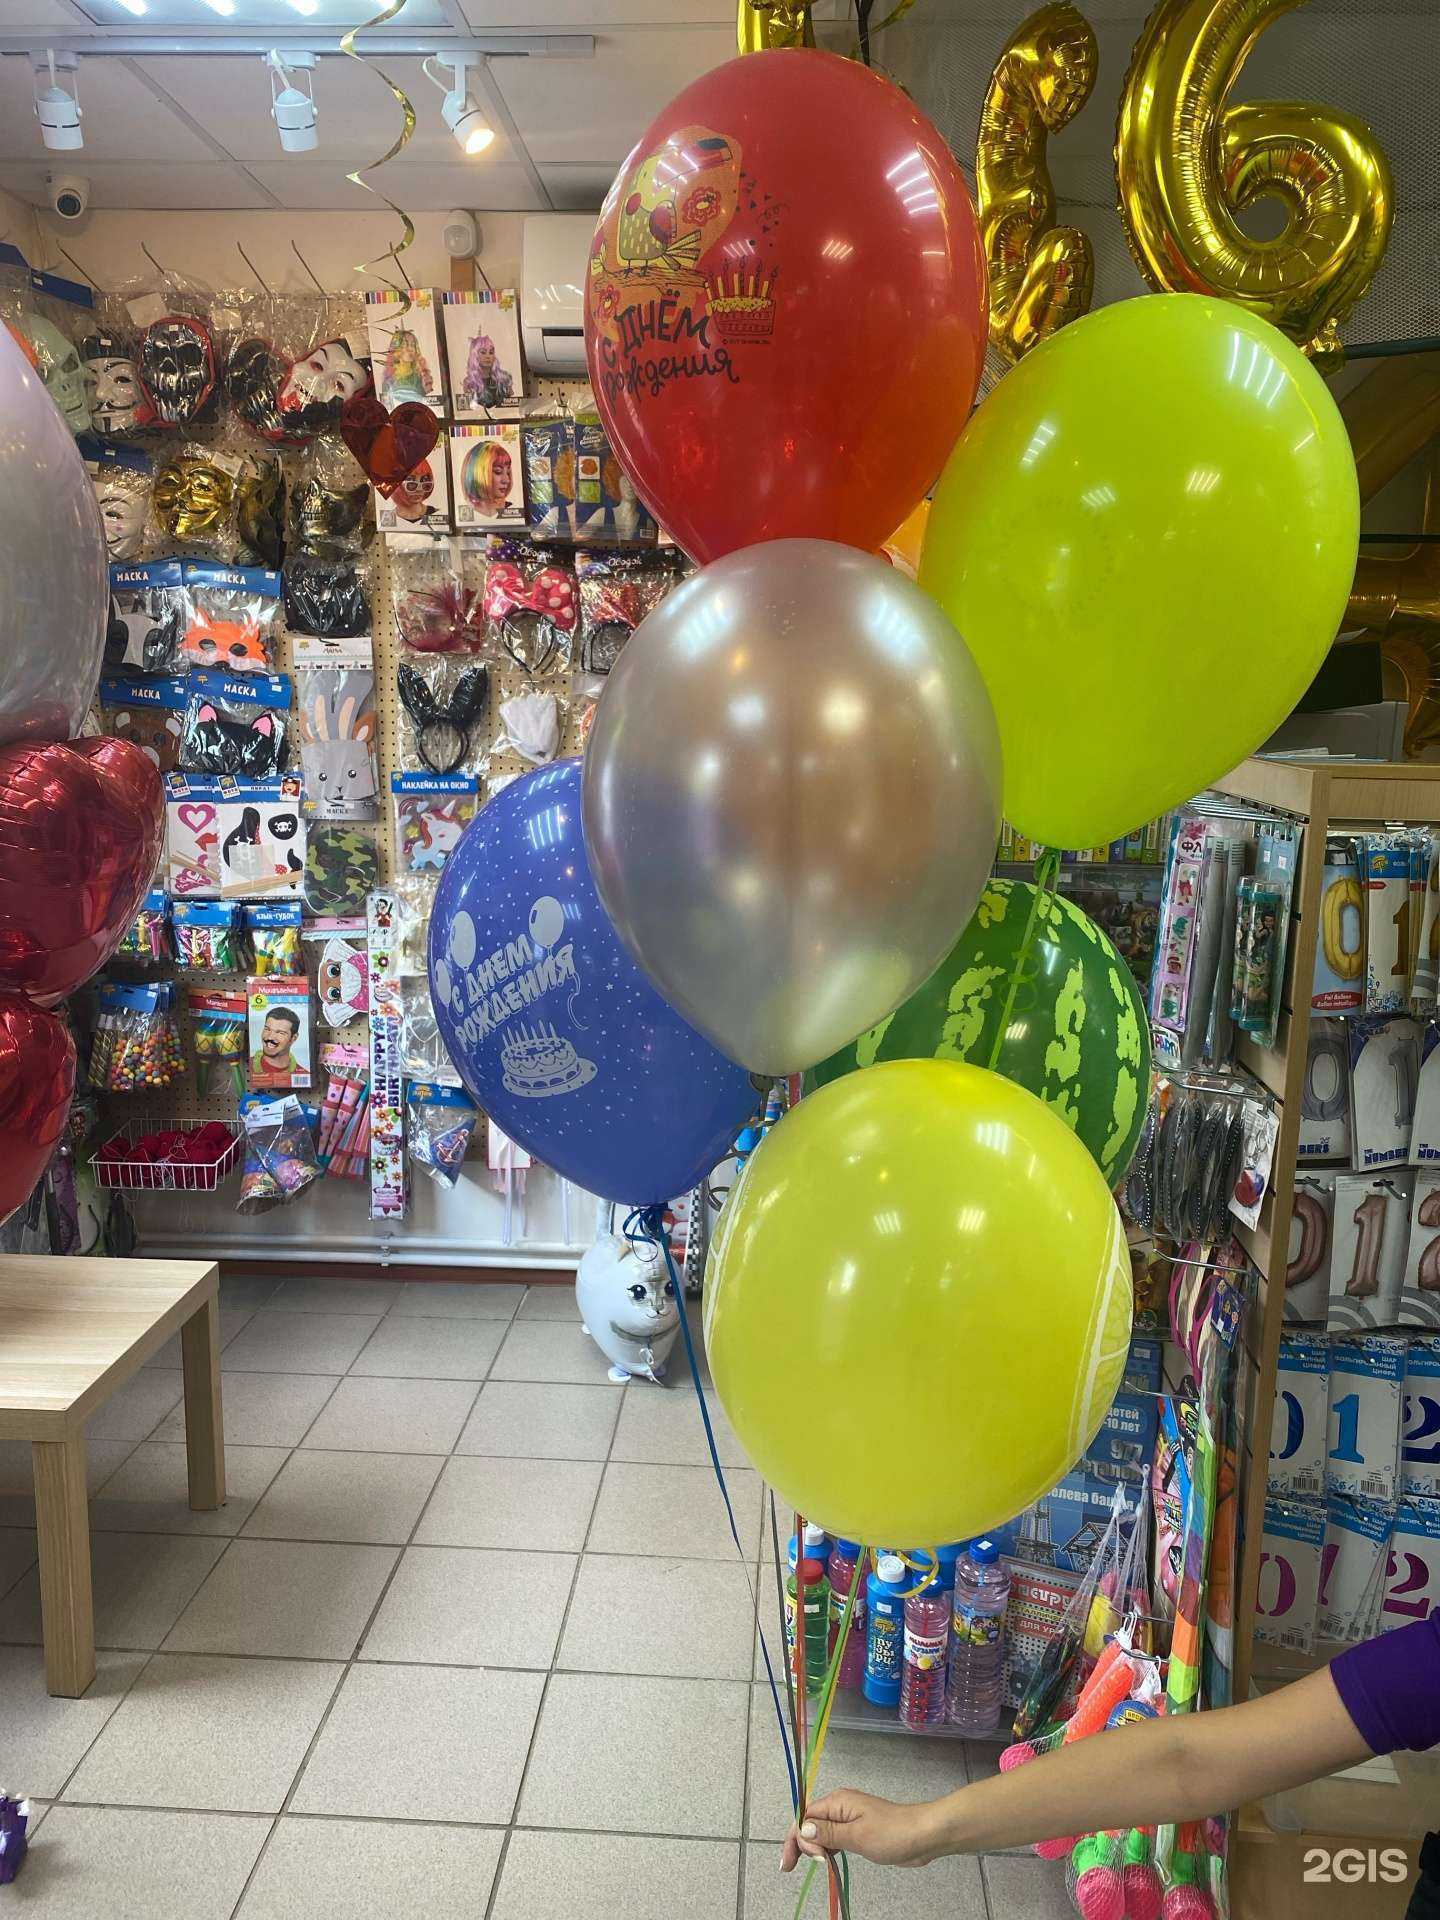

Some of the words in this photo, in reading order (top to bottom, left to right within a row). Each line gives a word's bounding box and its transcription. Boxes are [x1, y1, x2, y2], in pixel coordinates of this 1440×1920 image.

[614, 288, 711, 358] ДНЁМ
[116, 572, 149, 582] МАСКА
[213, 573, 246, 585] МАСКА
[131, 688, 161, 700] МАСКА
[223, 683, 257, 698] МАСКА
[401, 779, 438, 790] НАКЛЕЙКА
[439, 781, 449, 790] НА
[450, 781, 469, 790] ОКНО
[454, 943, 576, 1049] РОЖДЕНИЯ
[374, 1031, 386, 1091] HAPPY
[1298, 1143, 1330, 1154] BERS
[1120, 1420, 1141, 1433] лет
[1049, 1486, 1089, 1503] елева
[1020, 1620, 1040, 1631] ДЛЯ
